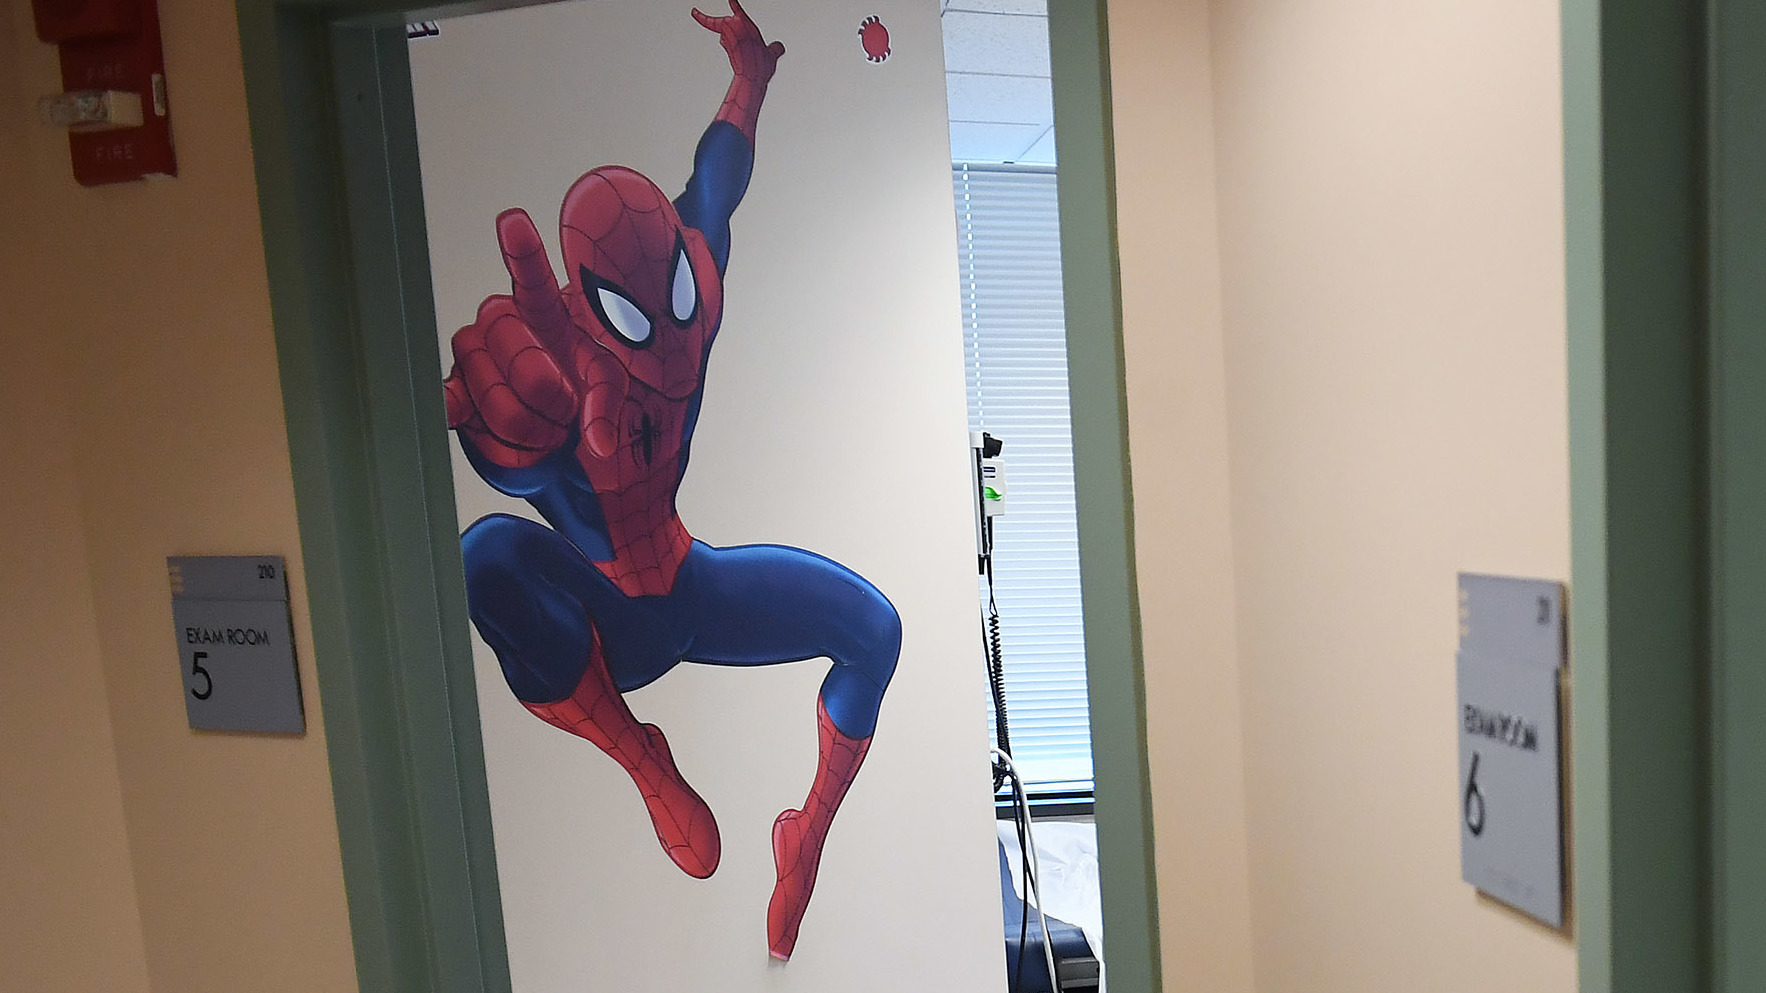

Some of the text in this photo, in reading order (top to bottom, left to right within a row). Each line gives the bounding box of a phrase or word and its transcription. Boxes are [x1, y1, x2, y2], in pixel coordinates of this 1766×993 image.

[186, 627, 271, 646] EXAM ROOM
[190, 651, 213, 700] 5
[1463, 751, 1486, 837] 6
